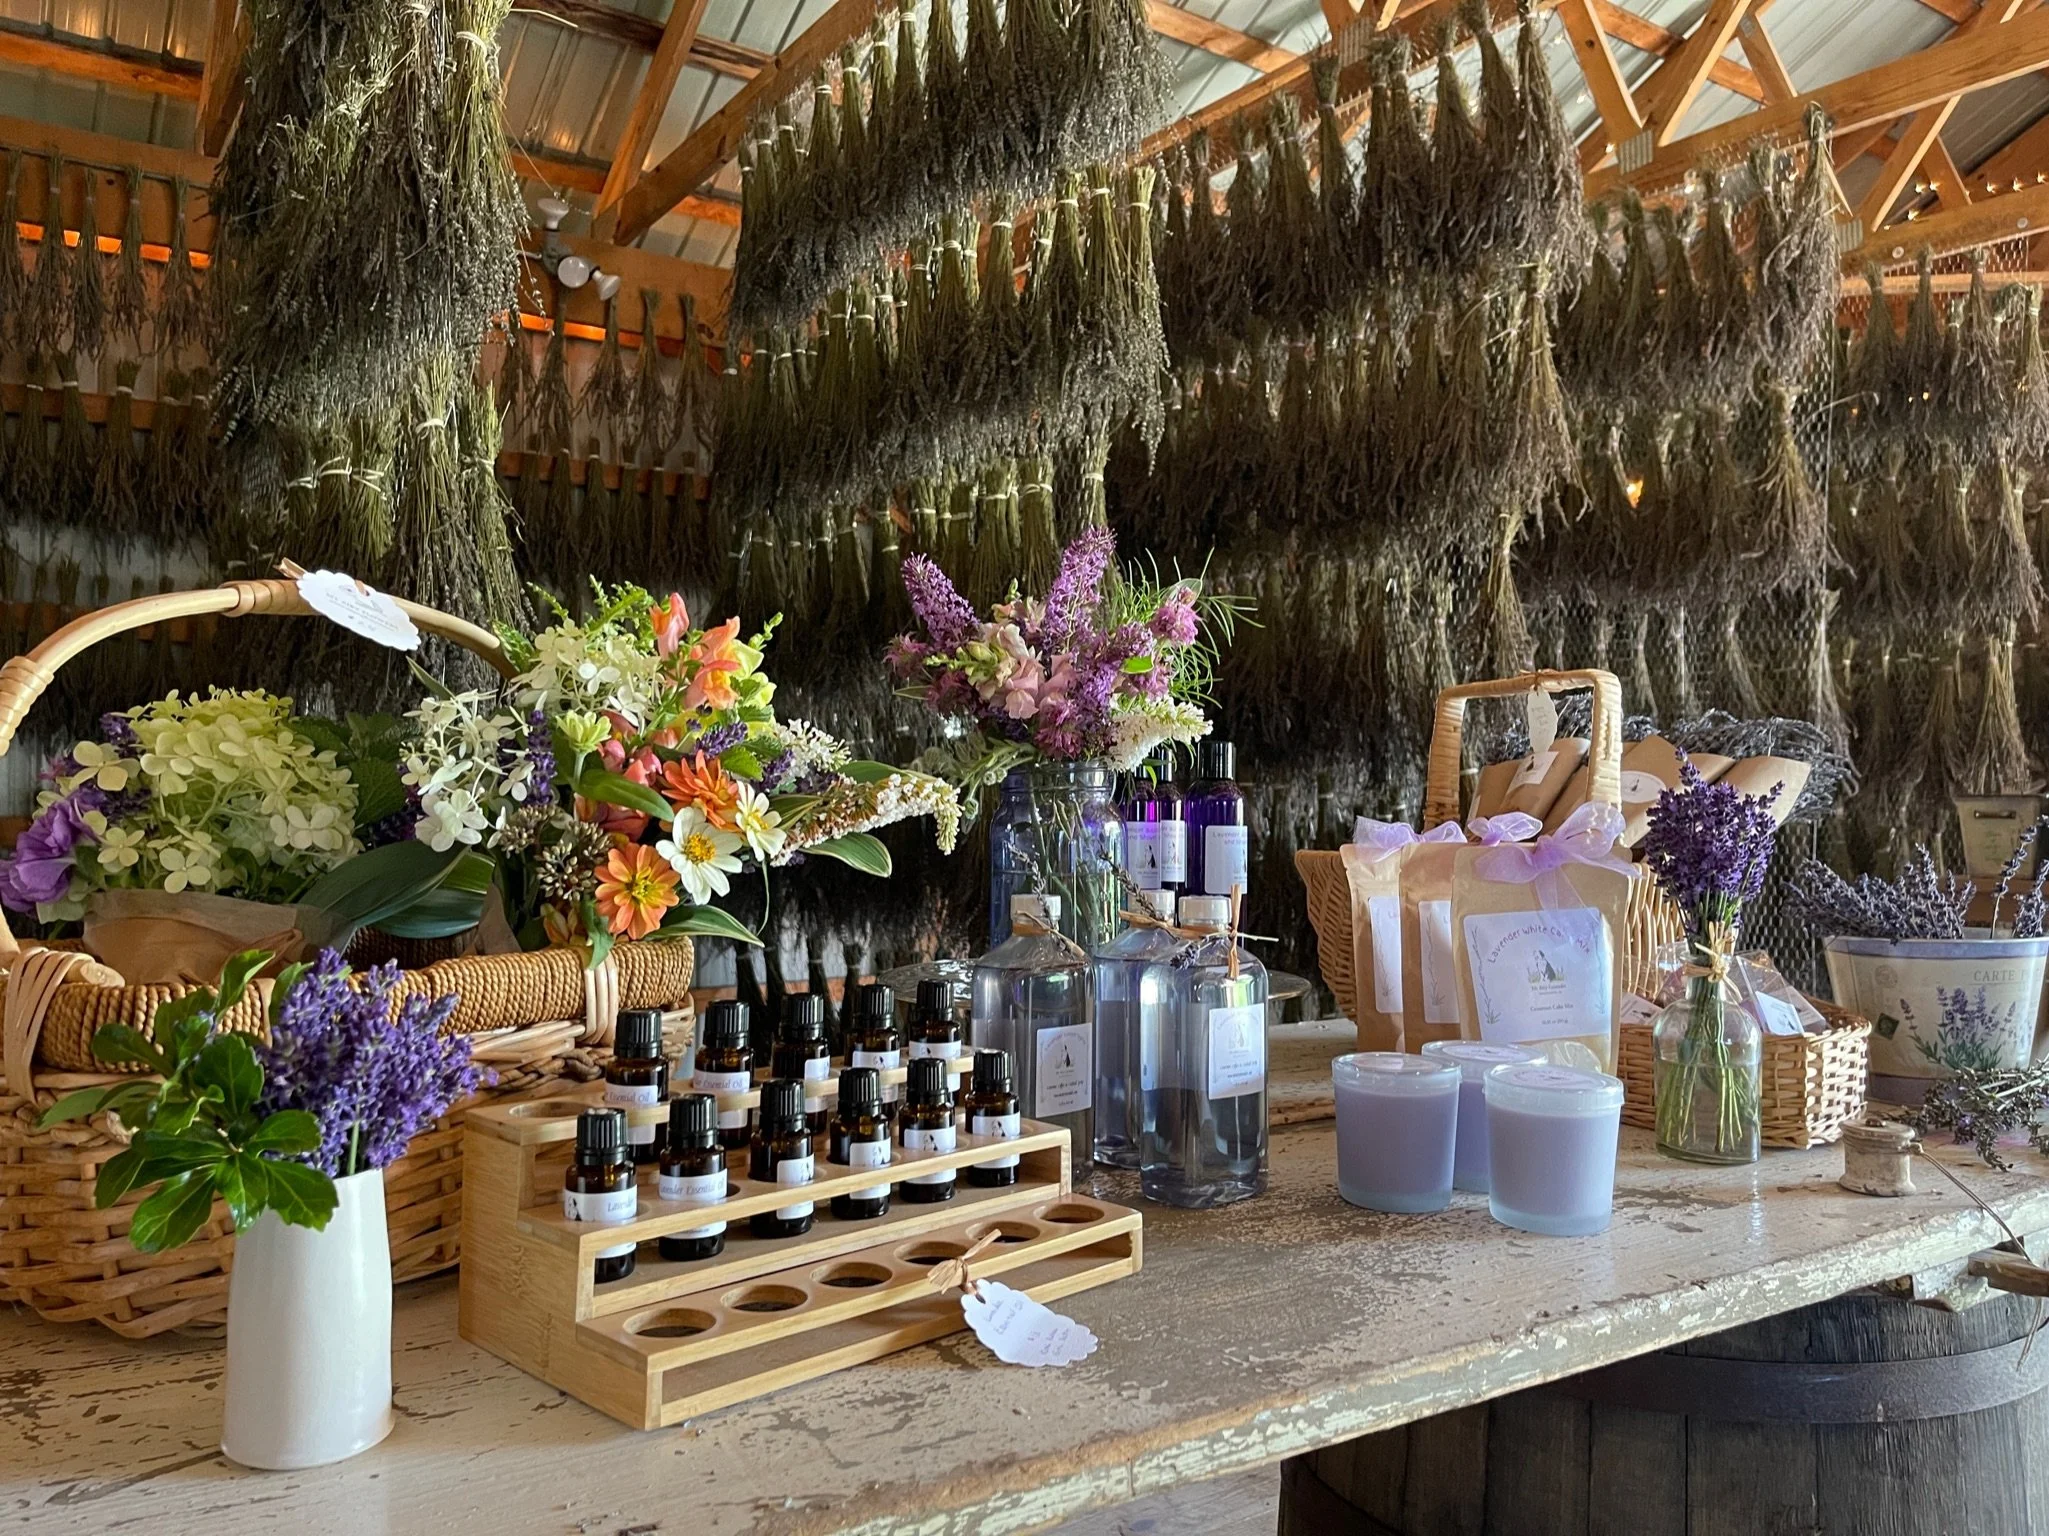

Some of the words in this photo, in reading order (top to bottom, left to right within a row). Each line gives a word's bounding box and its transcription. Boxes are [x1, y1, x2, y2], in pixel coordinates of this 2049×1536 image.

[1487, 929, 1521, 964] Lavender
[1522, 924, 1548, 936] White
[1973, 969, 2016, 982] CARTE
